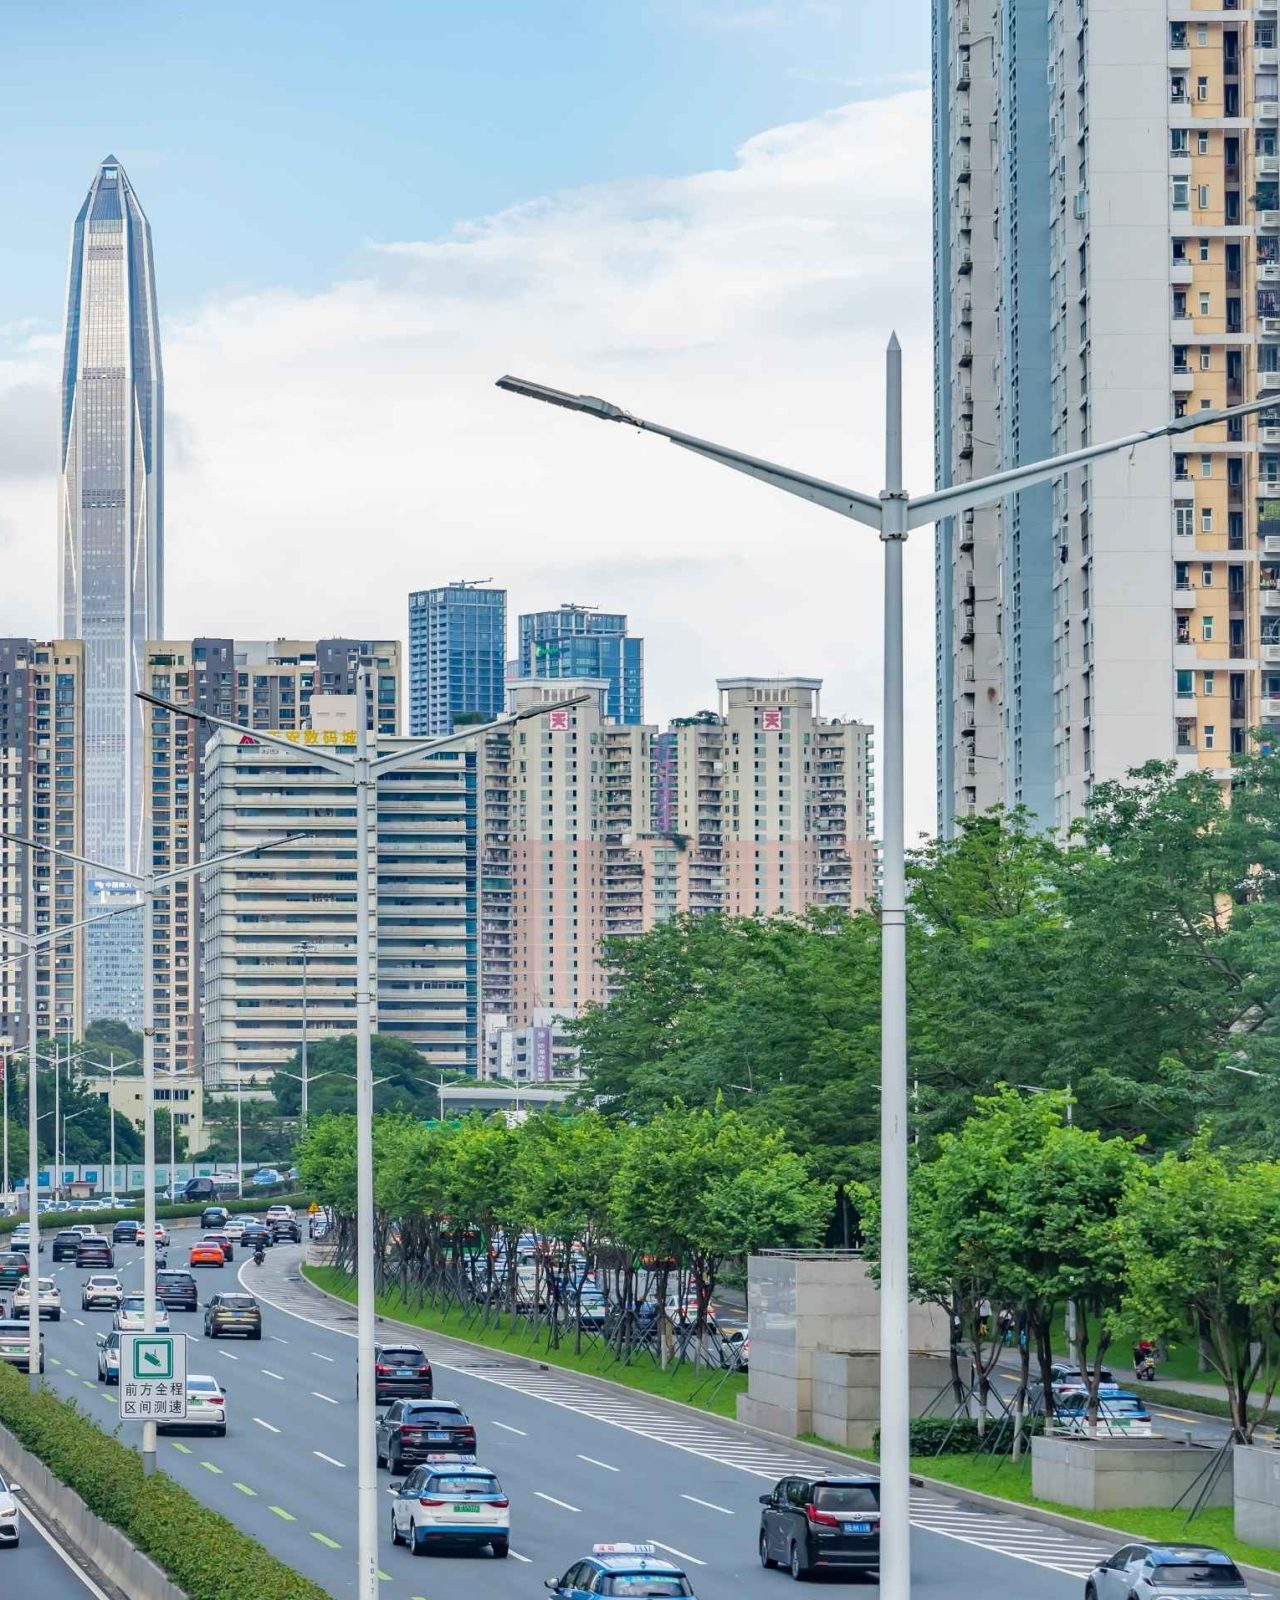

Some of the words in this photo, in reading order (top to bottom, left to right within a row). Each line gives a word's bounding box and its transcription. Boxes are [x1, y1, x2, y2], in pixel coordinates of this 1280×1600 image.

[124, 1382, 183, 1396] 前方全程
[124, 1400, 182, 1414] 区间测速
[634, 1544, 652, 1552] TAXI
